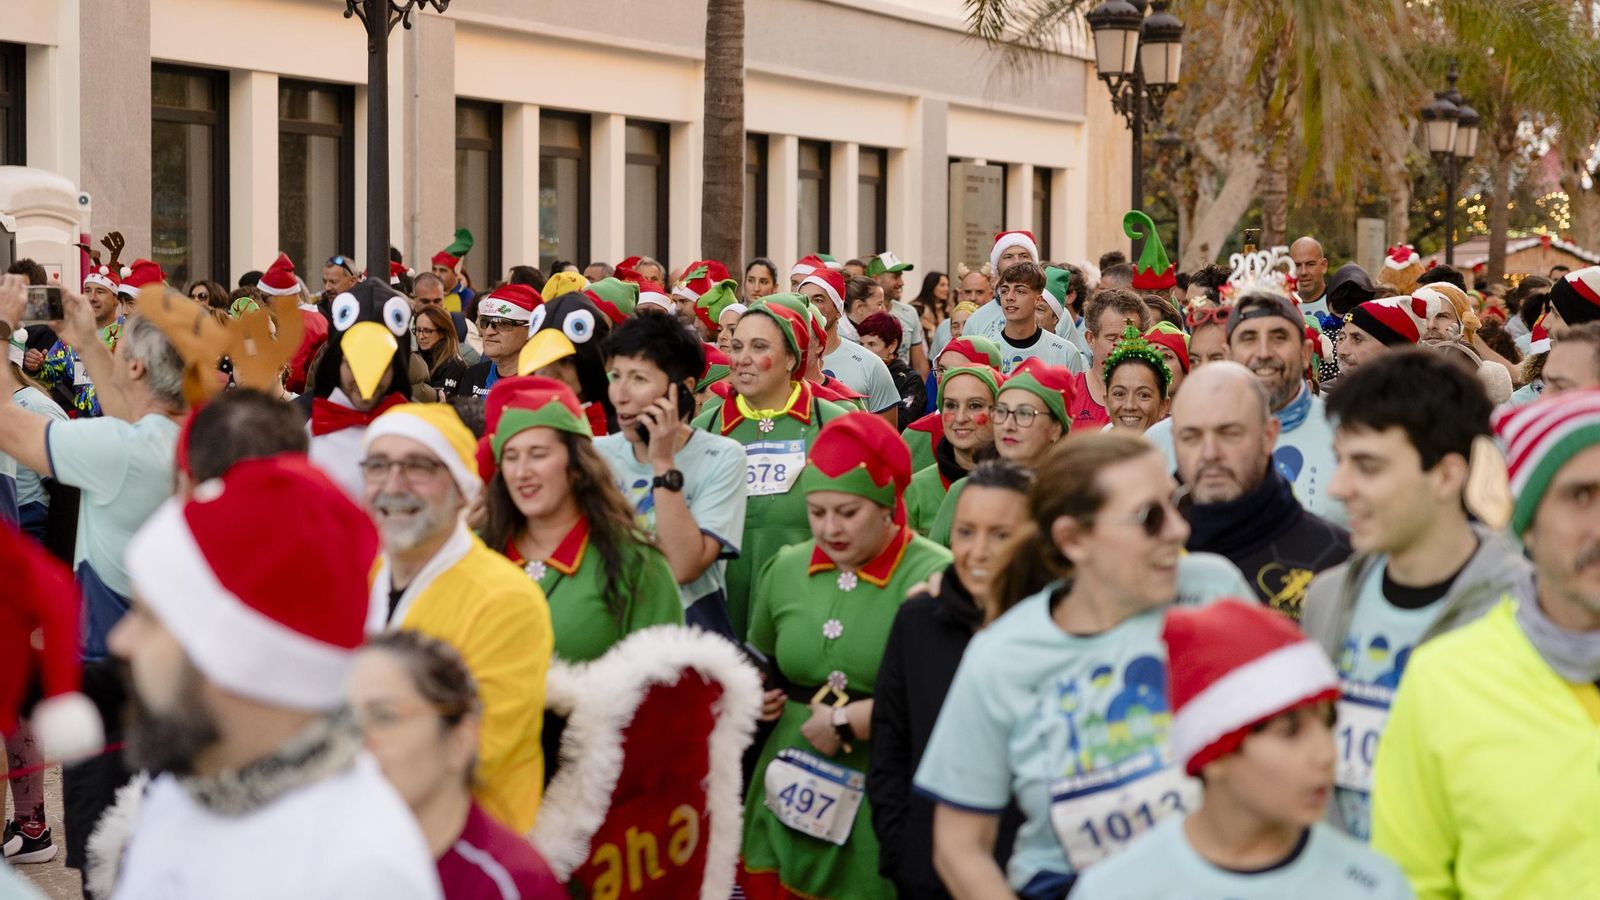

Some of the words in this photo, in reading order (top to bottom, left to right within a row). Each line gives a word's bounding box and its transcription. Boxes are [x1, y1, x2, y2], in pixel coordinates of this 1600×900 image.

[1226, 245, 1297, 286] 2025
[746, 463, 786, 484] 678
[779, 781, 836, 819] 497
